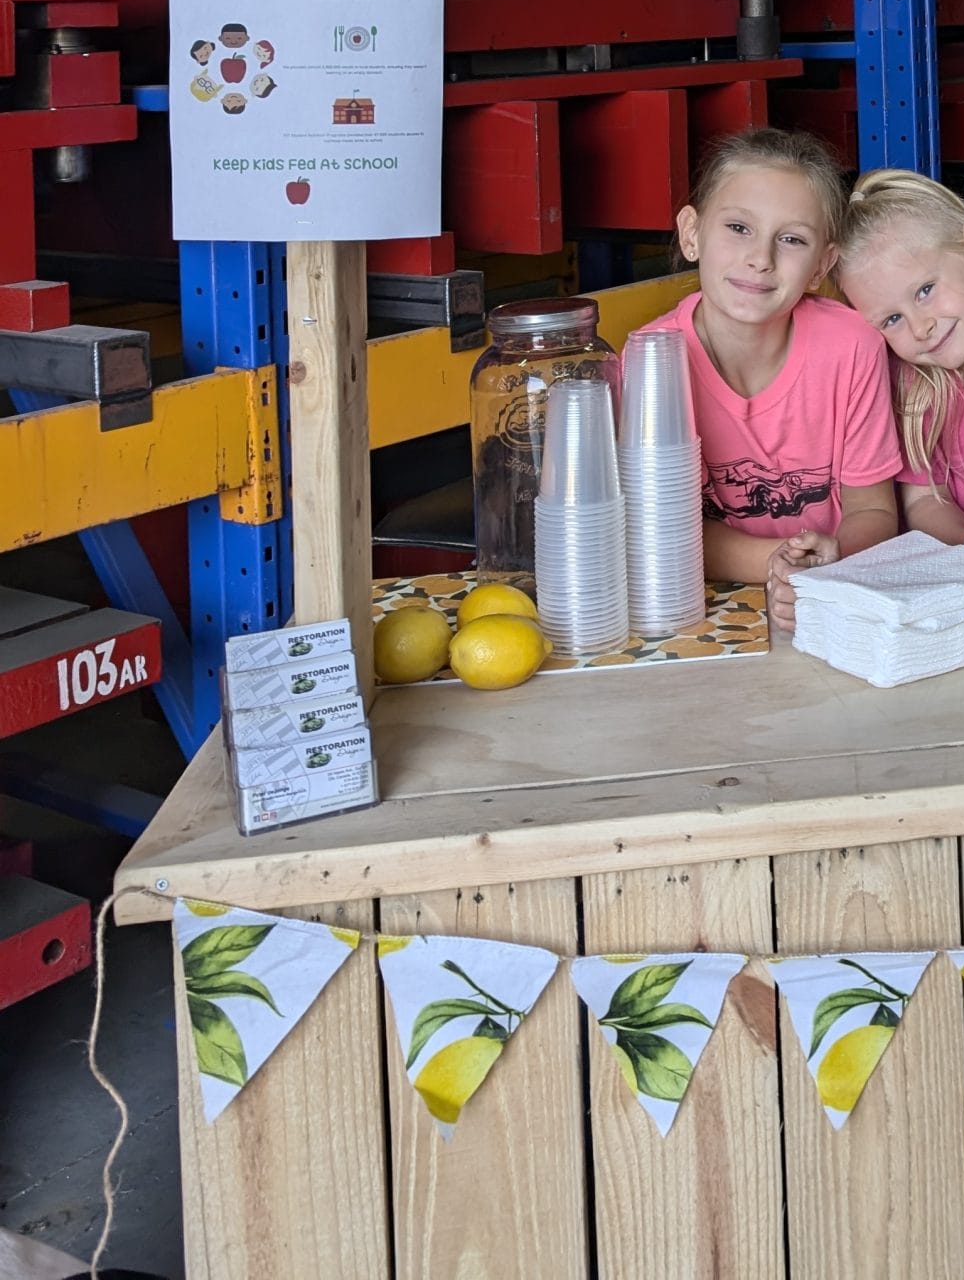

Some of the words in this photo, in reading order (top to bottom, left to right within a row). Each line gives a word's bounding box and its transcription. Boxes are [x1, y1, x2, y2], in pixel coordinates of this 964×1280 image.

[320, 158, 341, 170] At
[288, 628, 346, 644] RESTORATION
[291, 663, 350, 681] RESTORATION
[299, 701, 358, 721] RESTORATION
[305, 736, 366, 755] RESTORATION
